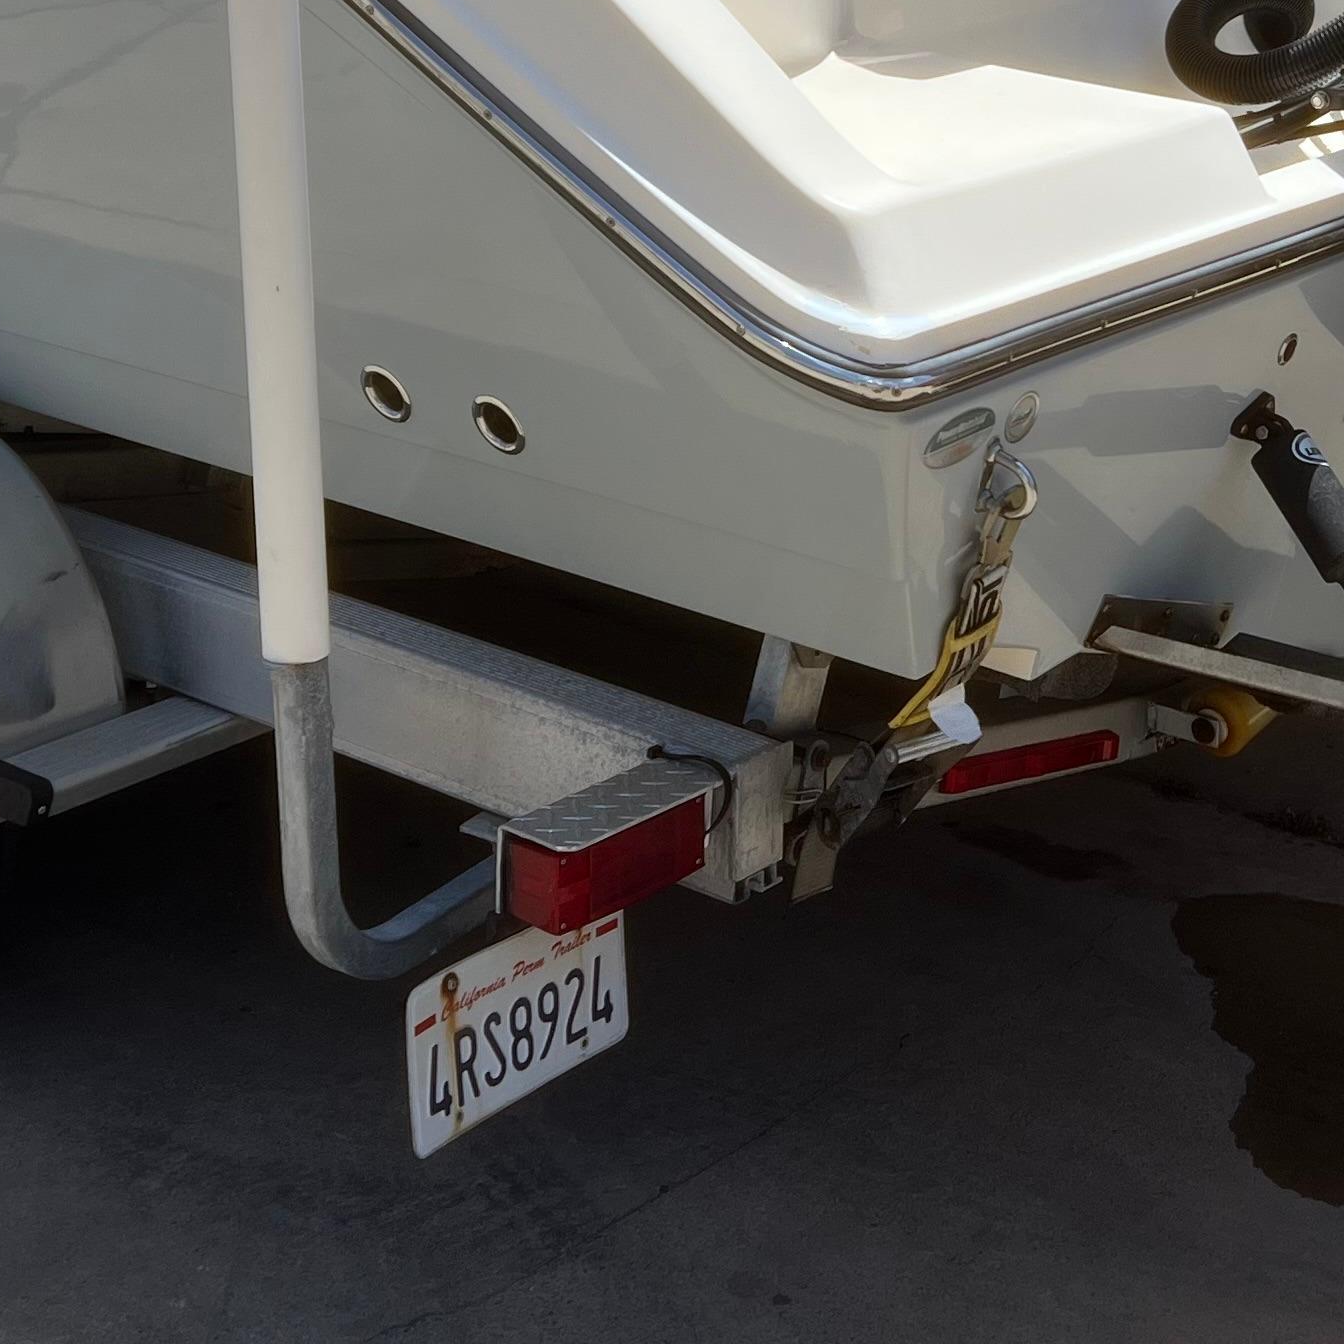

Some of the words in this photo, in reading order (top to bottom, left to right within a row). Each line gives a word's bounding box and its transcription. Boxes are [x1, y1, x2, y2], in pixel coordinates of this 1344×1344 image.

[429, 955, 614, 1117] 4RS8924
[440, 975, 507, 1023] California
[511, 957, 545, 983] Perm
[551, 930, 592, 960] Trailer
